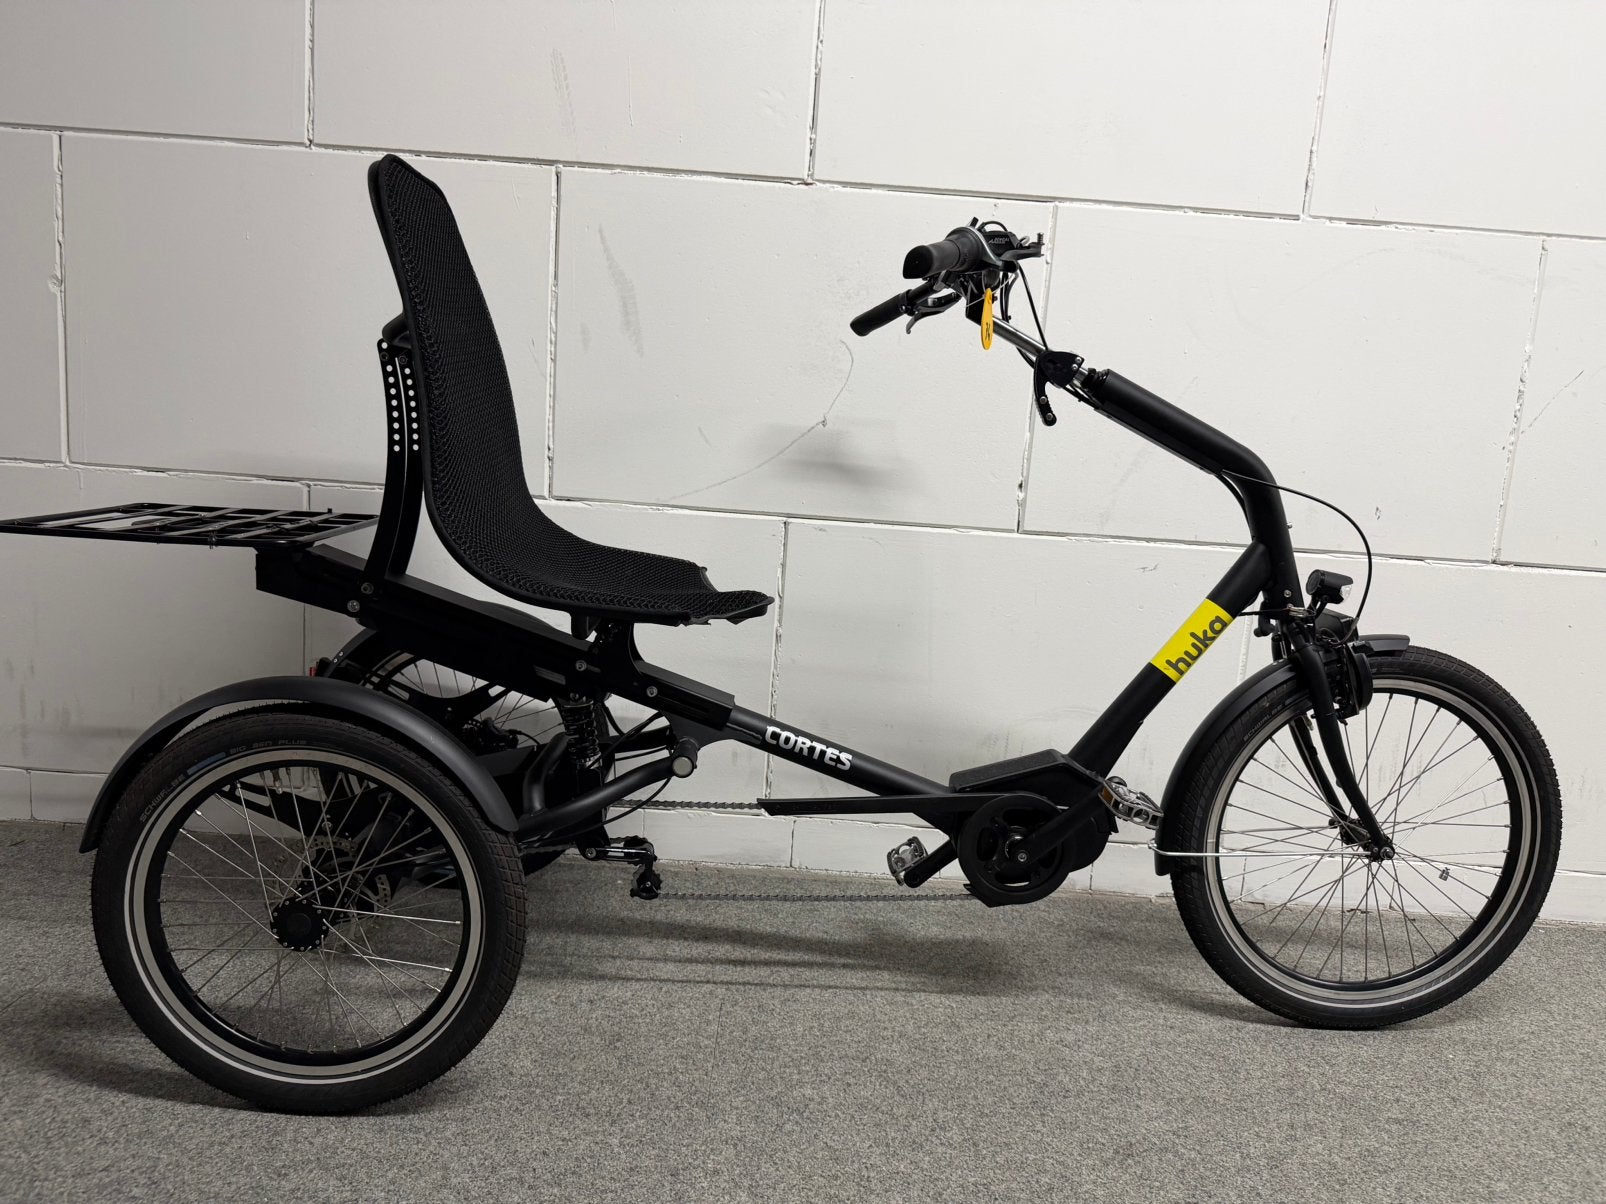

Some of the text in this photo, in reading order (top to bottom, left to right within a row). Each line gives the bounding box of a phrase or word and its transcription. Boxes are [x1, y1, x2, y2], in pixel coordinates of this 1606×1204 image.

[1165, 615, 1228, 676] huka
[229, 745, 248, 755] BIG
[764, 725, 853, 771] CORTES
